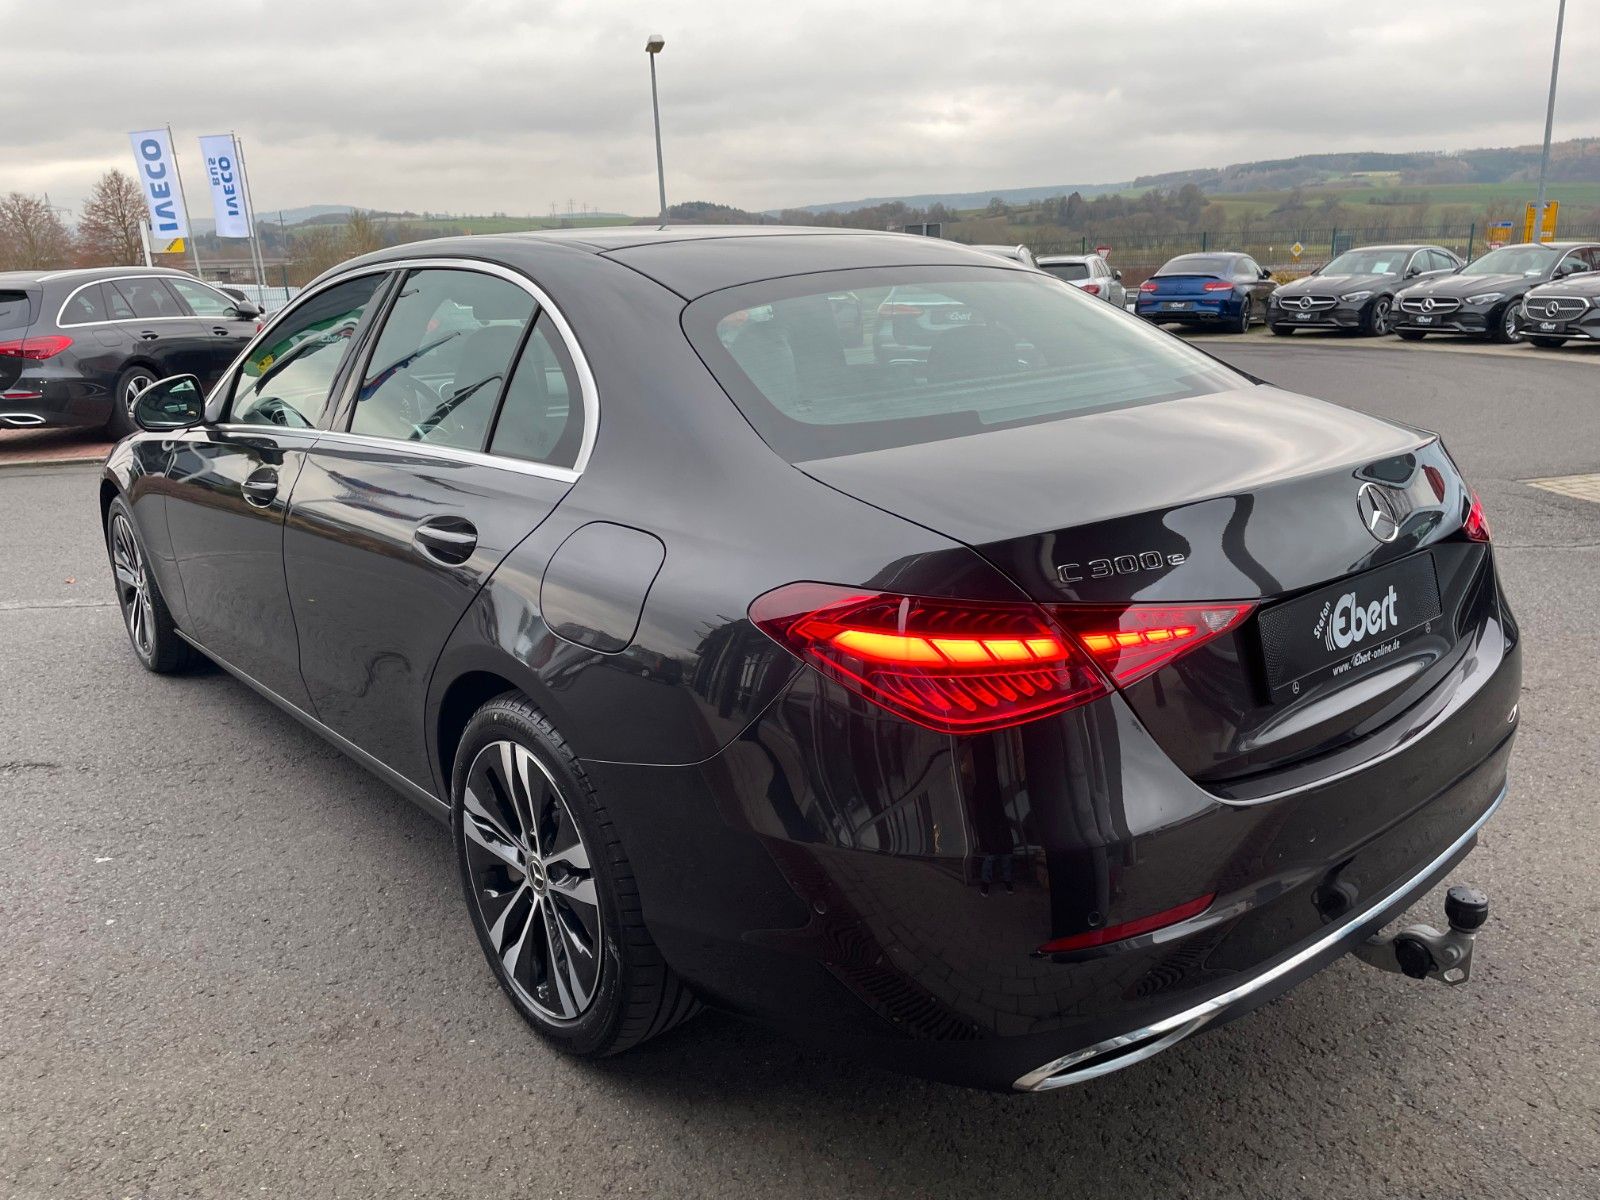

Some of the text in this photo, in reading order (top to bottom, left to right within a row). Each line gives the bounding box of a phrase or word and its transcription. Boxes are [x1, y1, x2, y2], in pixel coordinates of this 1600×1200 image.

[1057, 563, 1083, 584] C
[1088, 550, 1164, 579] 300
[1313, 601, 1331, 640] Stefan
[1332, 585, 1398, 649] Ebert
